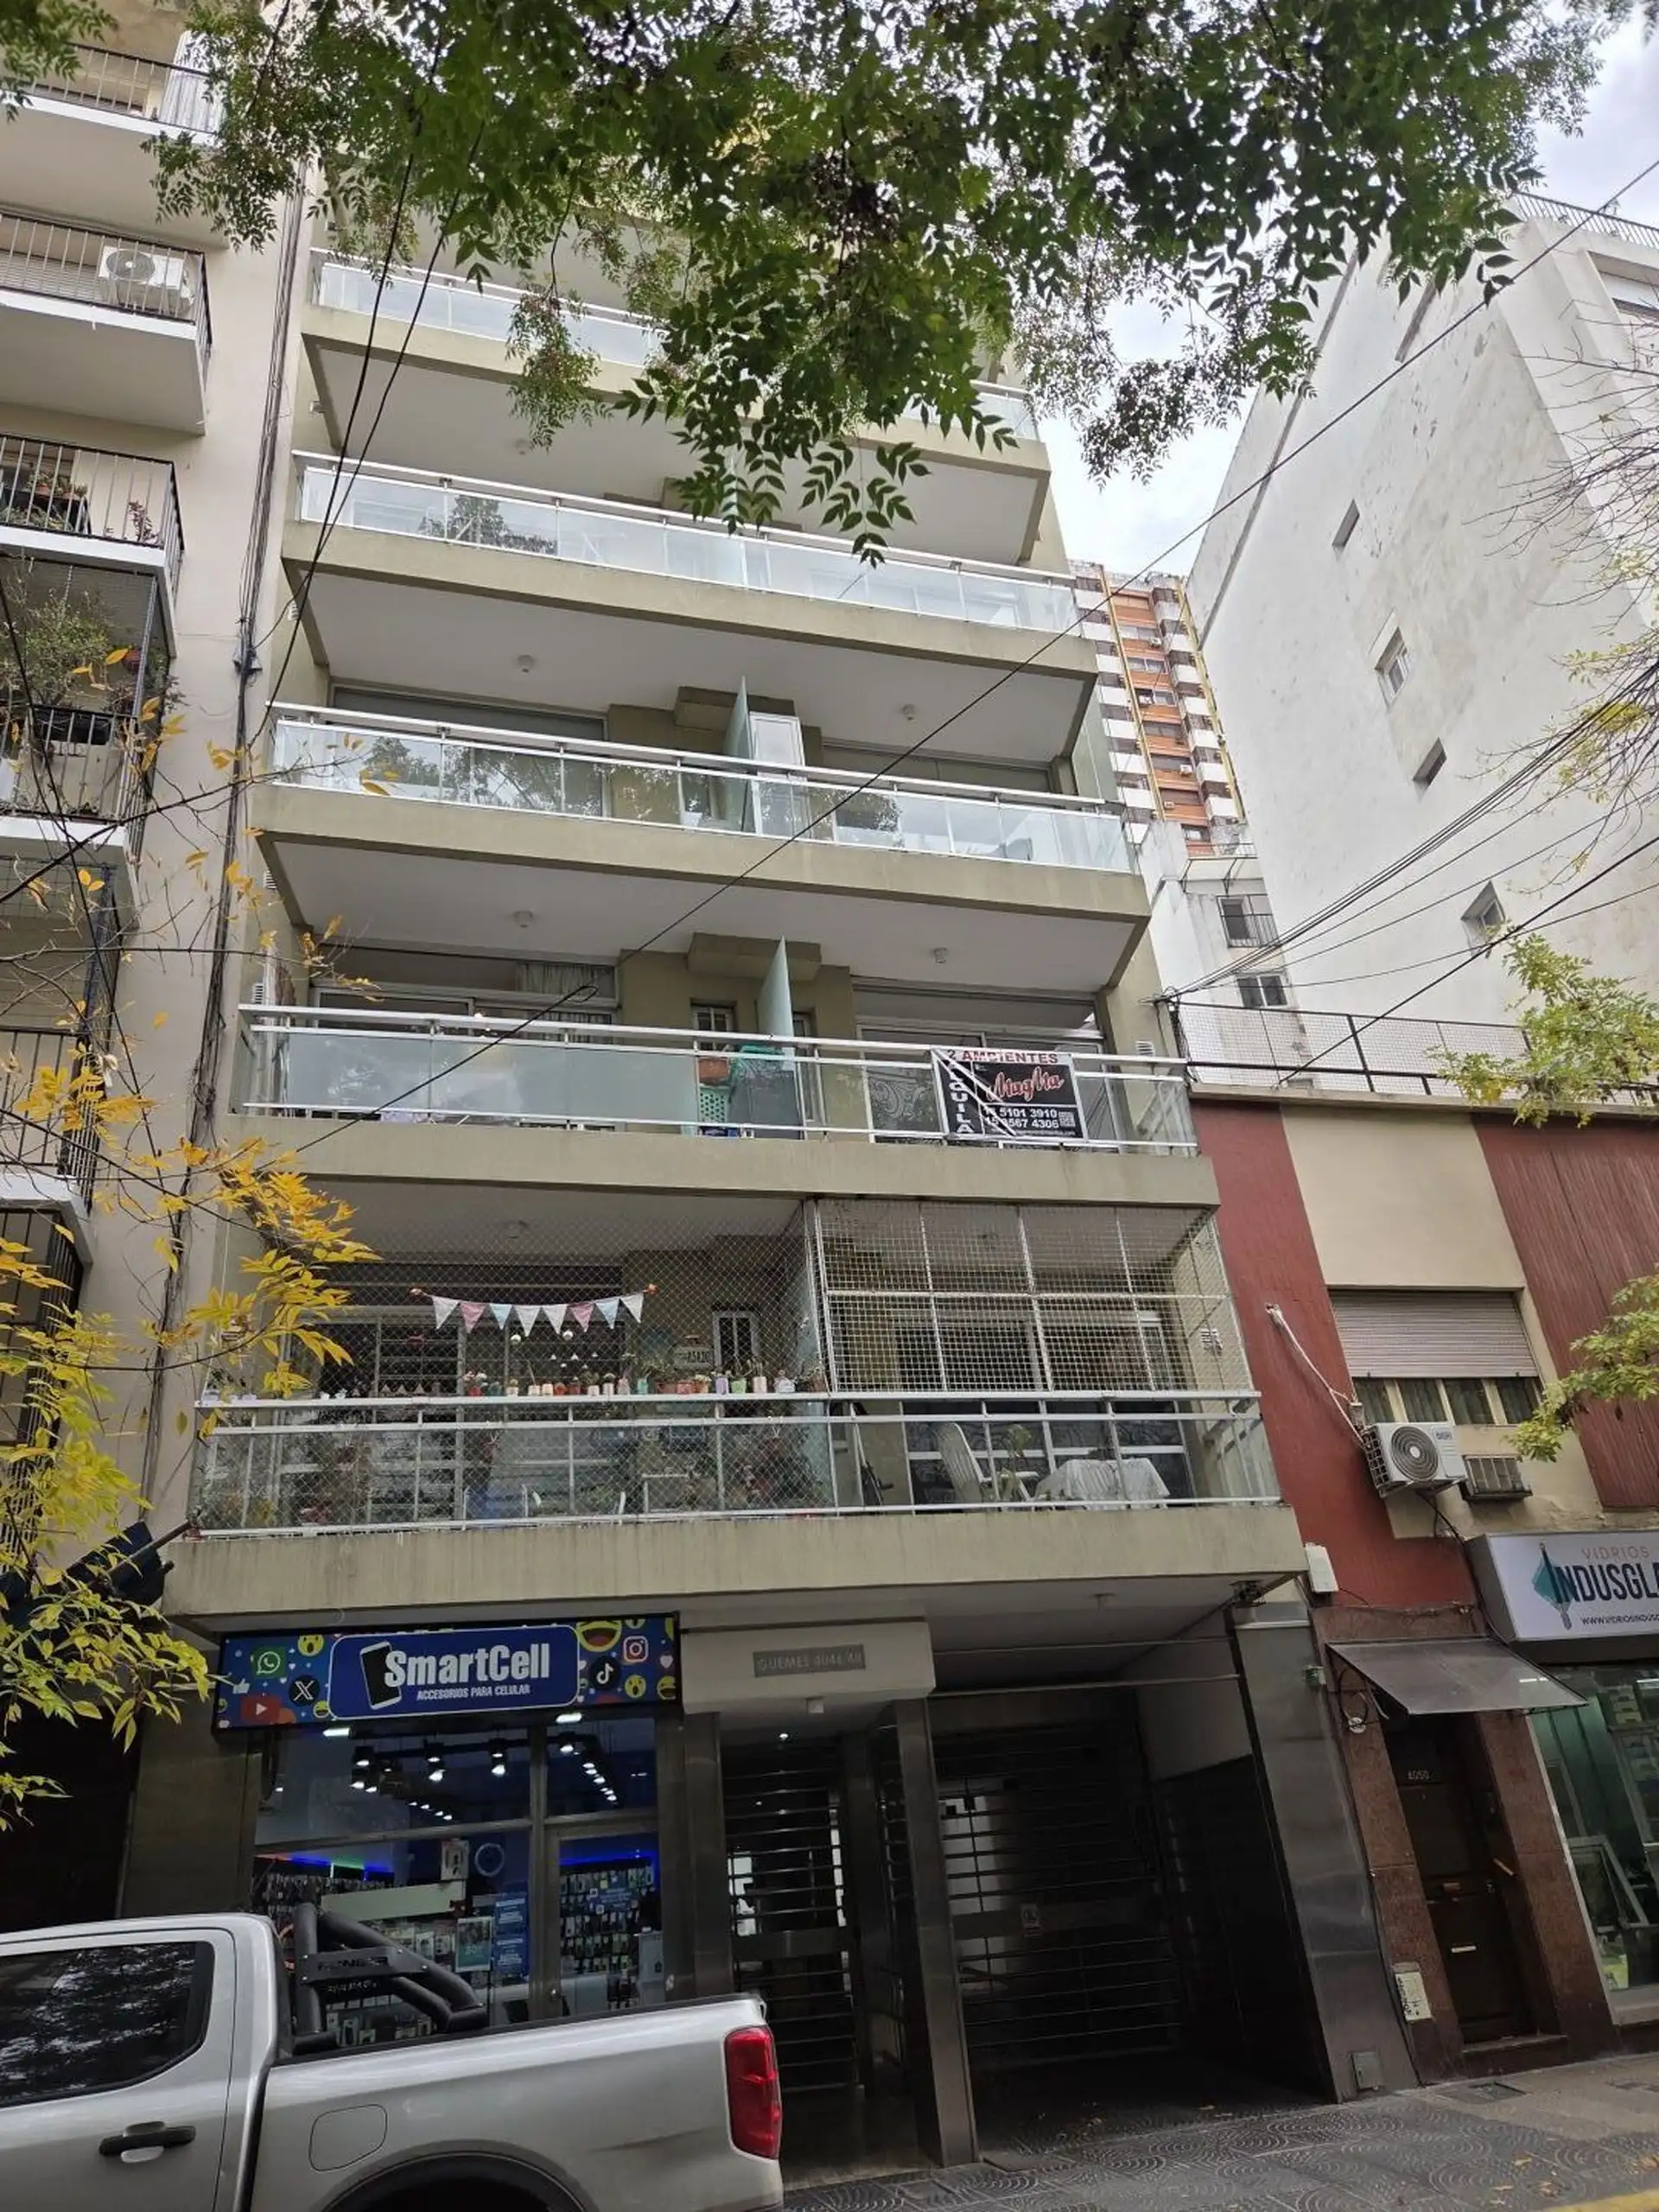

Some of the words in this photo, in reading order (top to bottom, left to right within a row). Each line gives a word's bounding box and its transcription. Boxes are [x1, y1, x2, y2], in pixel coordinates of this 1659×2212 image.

[947, 1049, 957, 1060] 2
[999, 1108, 1027, 1117] 5101
[1581, 1546, 1649, 1560] VIDRIOS
[384, 1643, 550, 1687] SmartCell
[416, 1688, 469, 1701] ACCESORIOS
[470, 1687, 493, 1698] PARA
[493, 1684, 531, 1696] CELULAR
